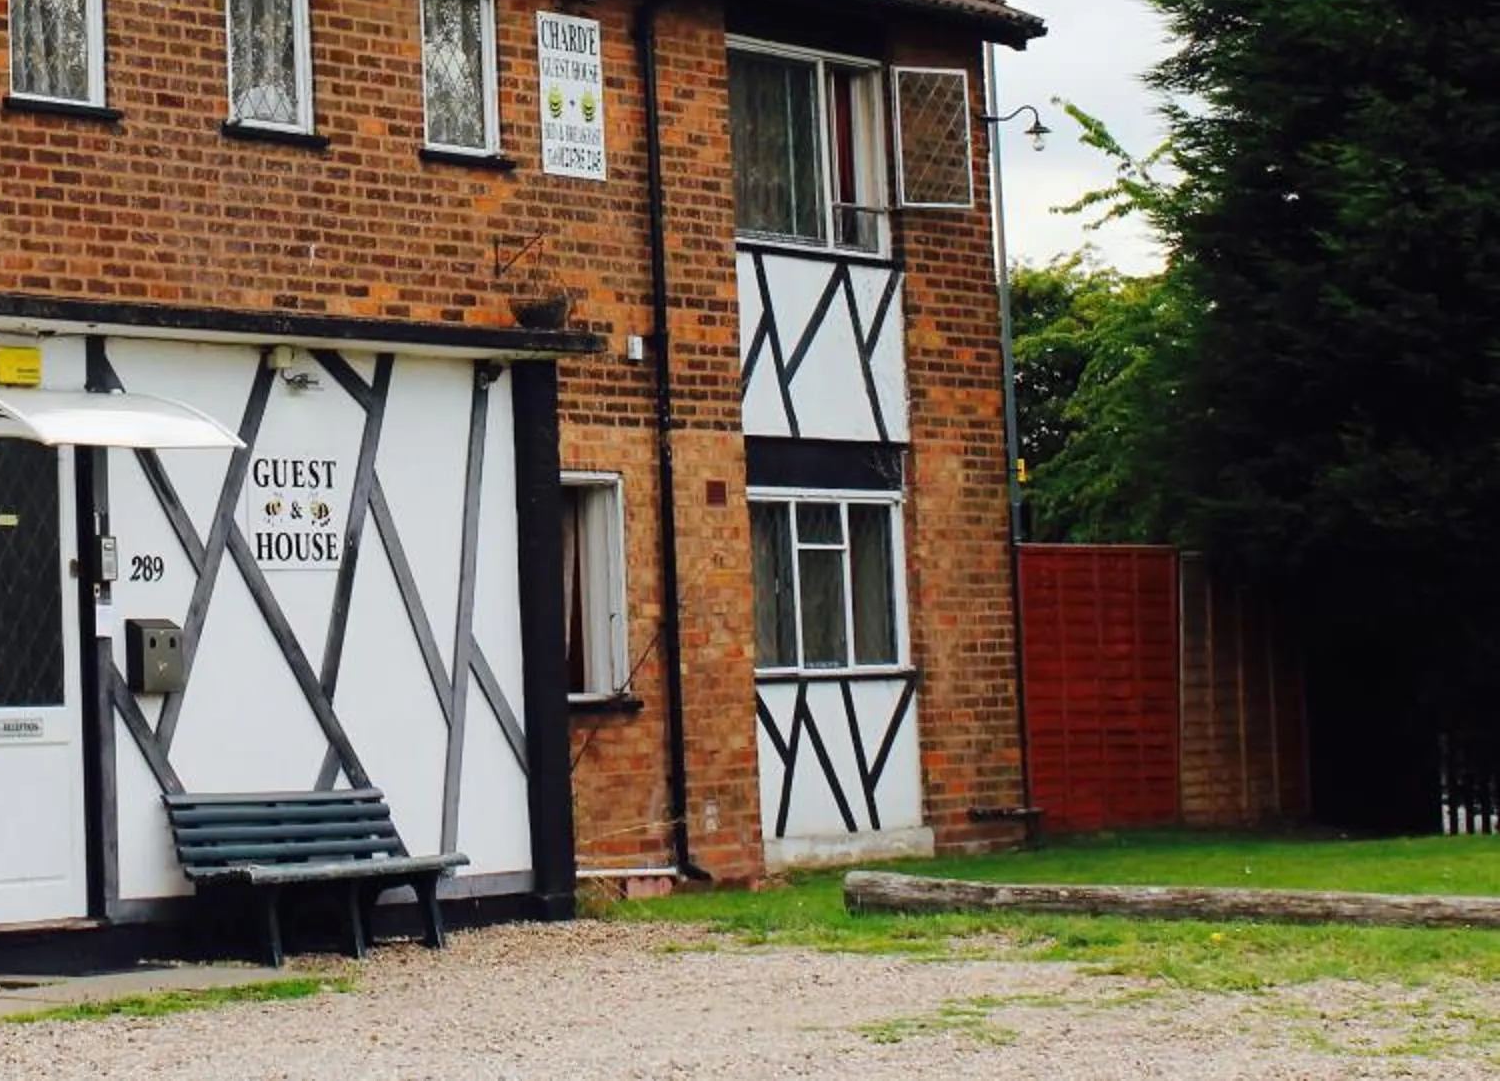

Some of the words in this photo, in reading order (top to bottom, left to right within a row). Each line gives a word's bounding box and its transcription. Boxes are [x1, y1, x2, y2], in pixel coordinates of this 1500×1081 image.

[542, 57, 569, 80] GUEST
[571, 61, 598, 84] HOUSE
[253, 458, 337, 489] GUEST
[290, 501, 303, 520] &
[255, 532, 339, 561] HOUSE
[129, 555, 164, 581] 289
